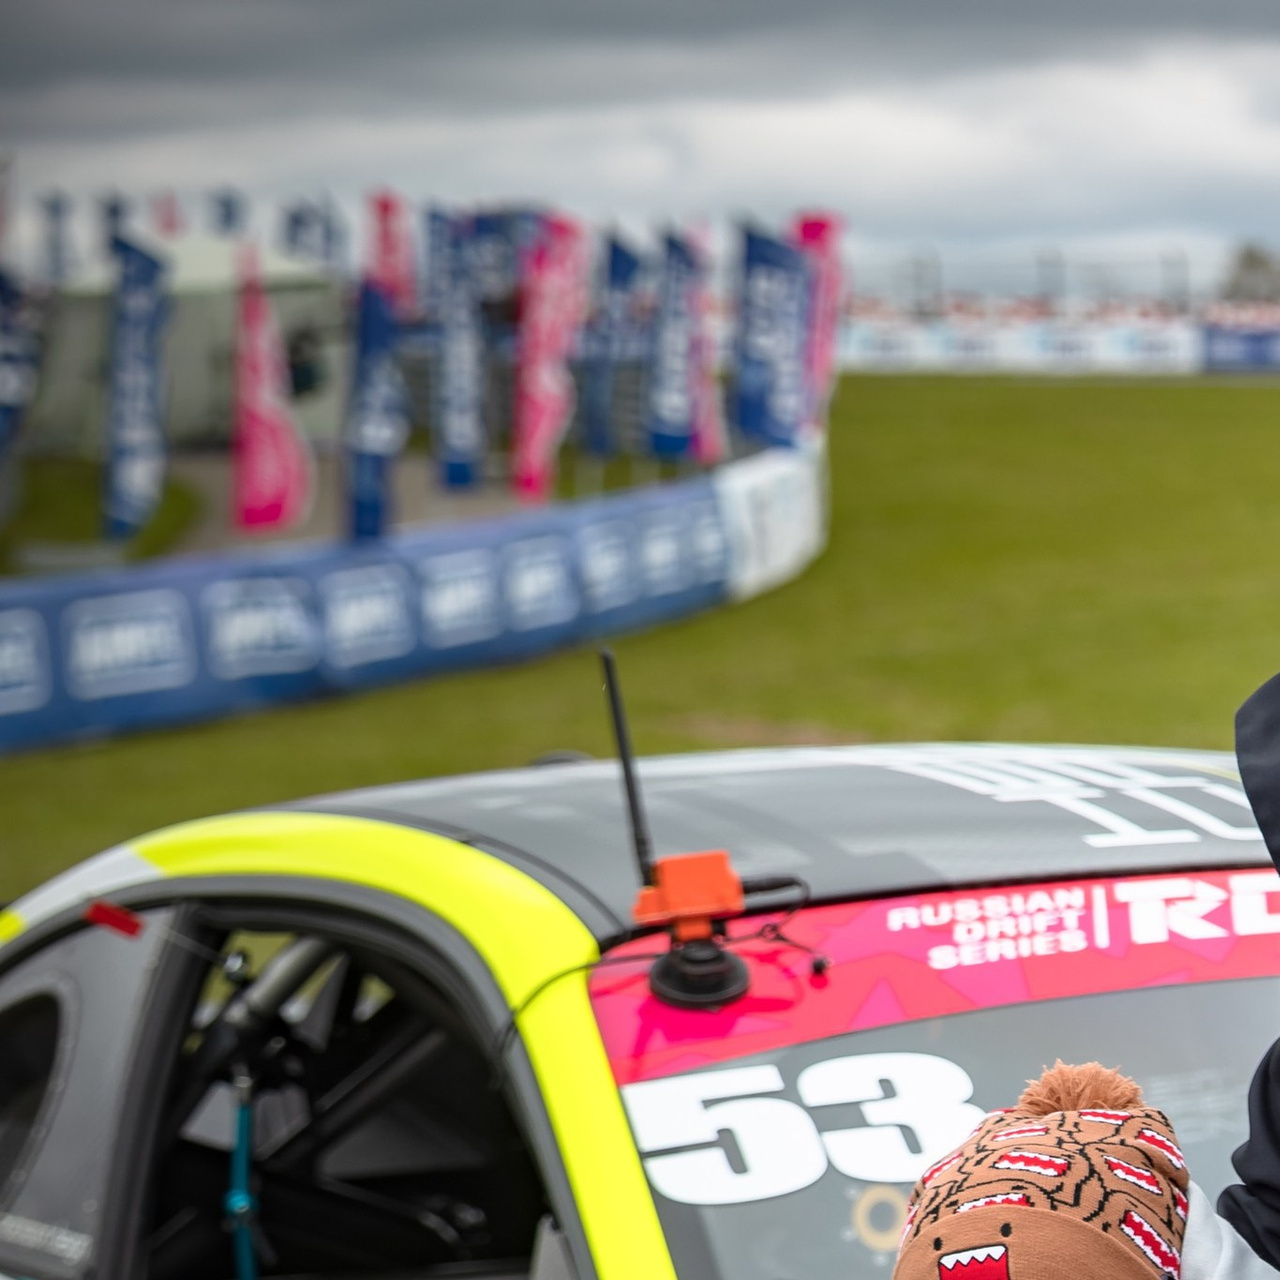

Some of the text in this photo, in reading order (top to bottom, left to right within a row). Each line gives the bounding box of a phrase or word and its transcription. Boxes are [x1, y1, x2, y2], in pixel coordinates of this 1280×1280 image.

[887, 887, 1085, 931] RUSSIAN
[953, 909, 1080, 945] DRIFT
[928, 929, 1087, 970] SERIES
[620, 1052, 986, 1205] 53
